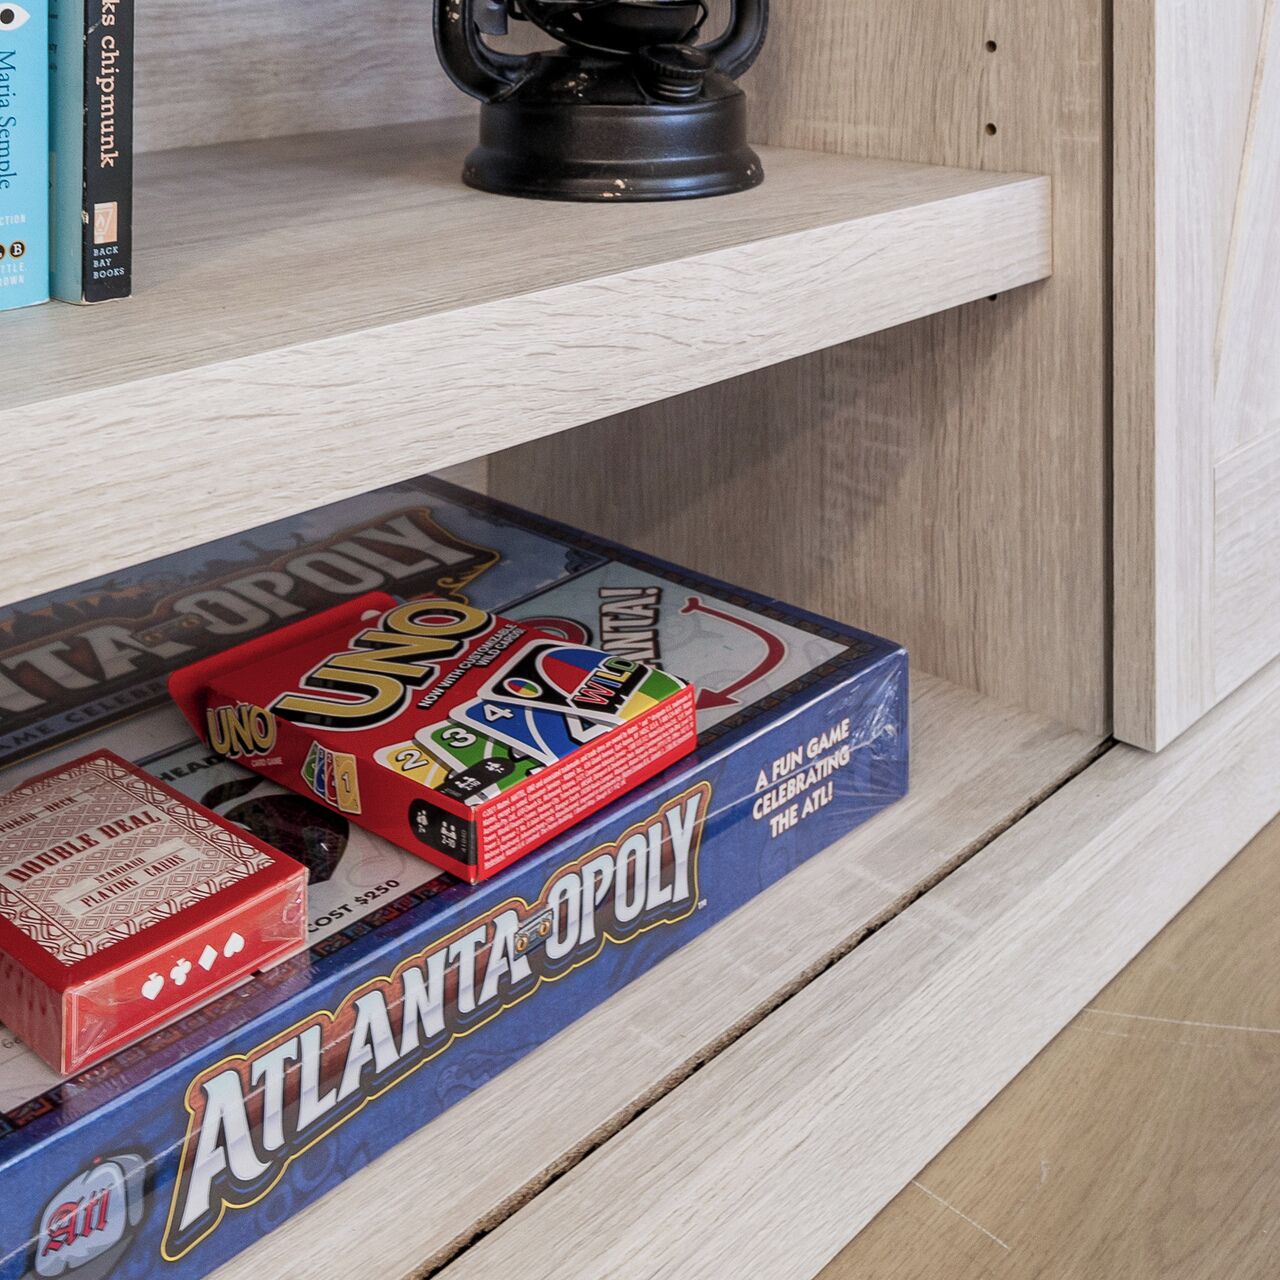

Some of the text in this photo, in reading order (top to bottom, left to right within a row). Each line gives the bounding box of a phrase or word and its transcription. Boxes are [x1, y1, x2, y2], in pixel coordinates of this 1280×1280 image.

[97, 34, 120, 168] chipmunk
[93, 245, 119, 257] BACK
[93, 258, 111, 269] BAY
[93, 267, 125, 280] BOOKS
[276, 600, 490, 723] UNO
[418, 624, 517, 707] NOW WITH CUSTOMIZABLE
[475, 647, 500, 666] WILD
[574, 657, 639, 705] WILD
[206, 703, 277, 757] UNO
[483, 703, 514, 722] 4
[441, 726, 477, 748] 3
[394, 749, 429, 771] 2
[755, 718, 850, 795] A FUN GAME
[753, 744, 850, 820] CELEBRATING
[43, 796, 79, 813] DECK
[769, 780, 833, 838] THE ATL!
[6, 810, 162, 883] DOUBLE DEAL
[80, 853, 186, 907] PLAYING CARDS
[93, 856, 147, 884] STANDARD
[353, 879, 401, 906] $250
